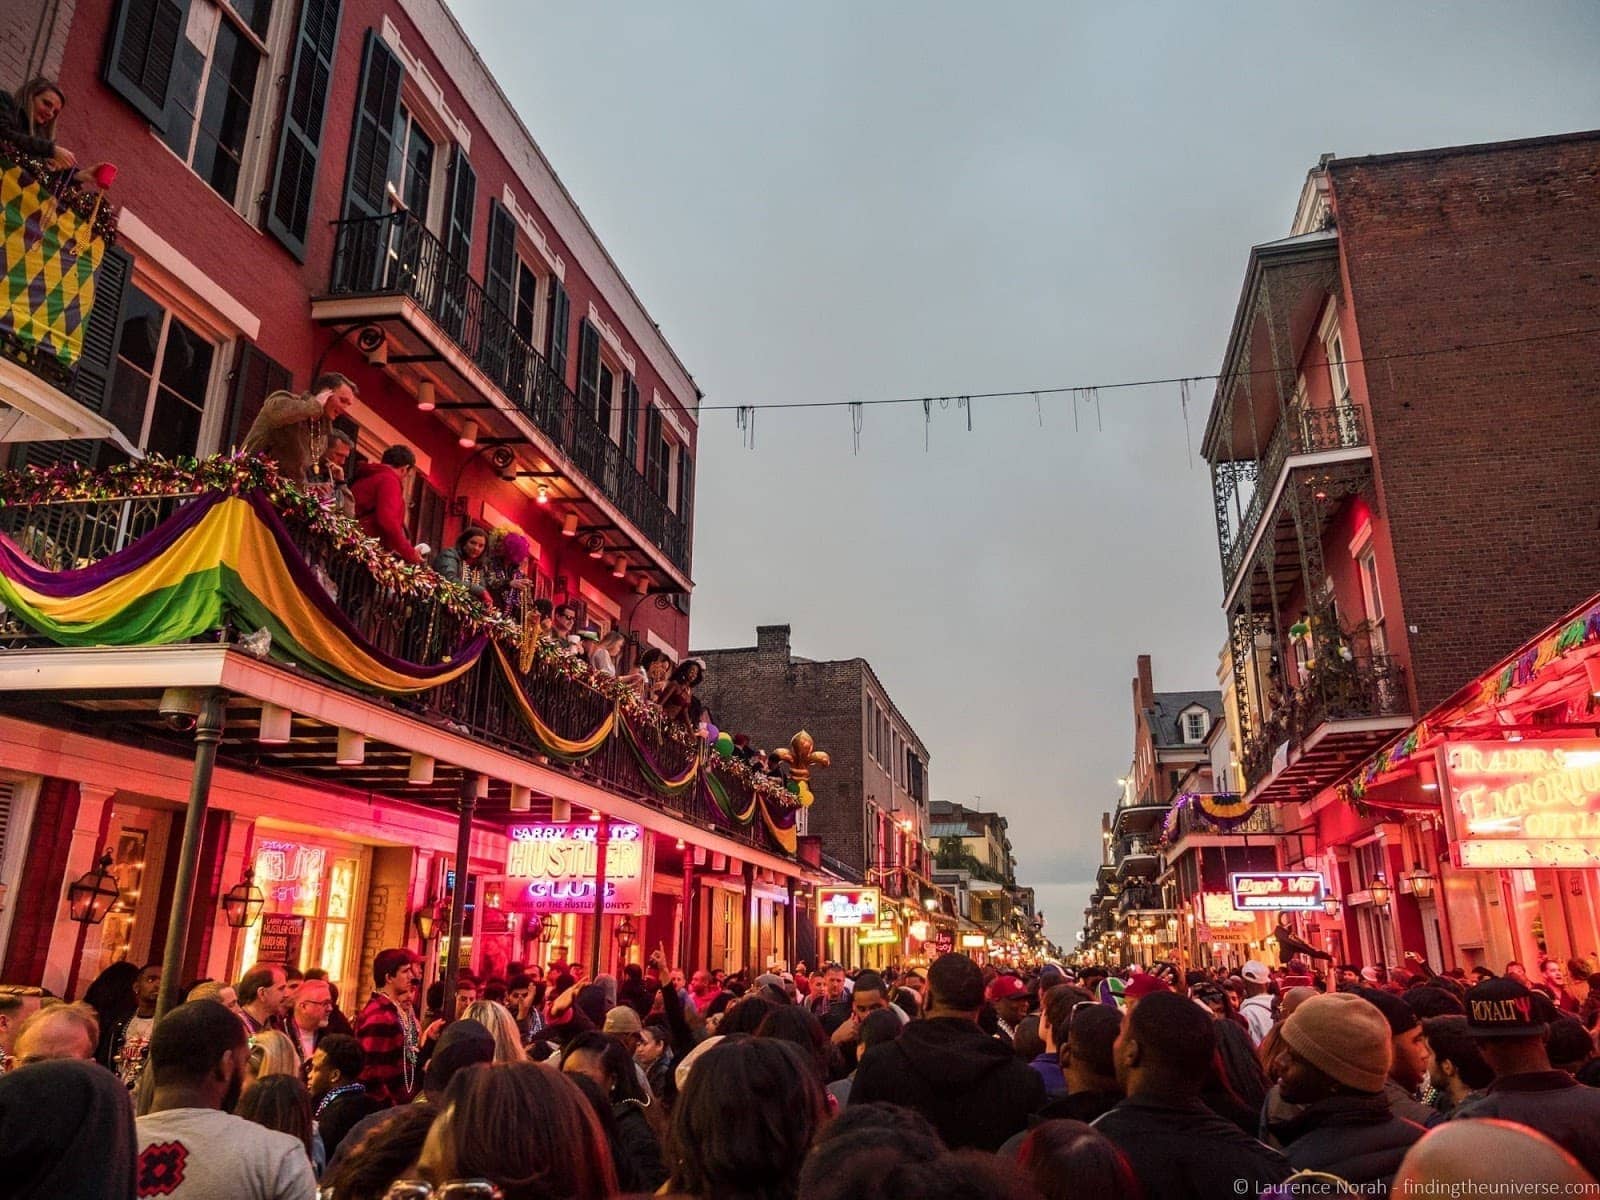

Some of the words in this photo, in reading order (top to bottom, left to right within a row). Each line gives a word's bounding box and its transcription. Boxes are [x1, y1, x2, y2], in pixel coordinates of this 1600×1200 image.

[1459, 766, 1600, 819] EMPORIU
[508, 841, 636, 877] HUSTLER
[529, 881, 616, 899] CLUB
[1471, 997, 1530, 1022] ROYALTY
